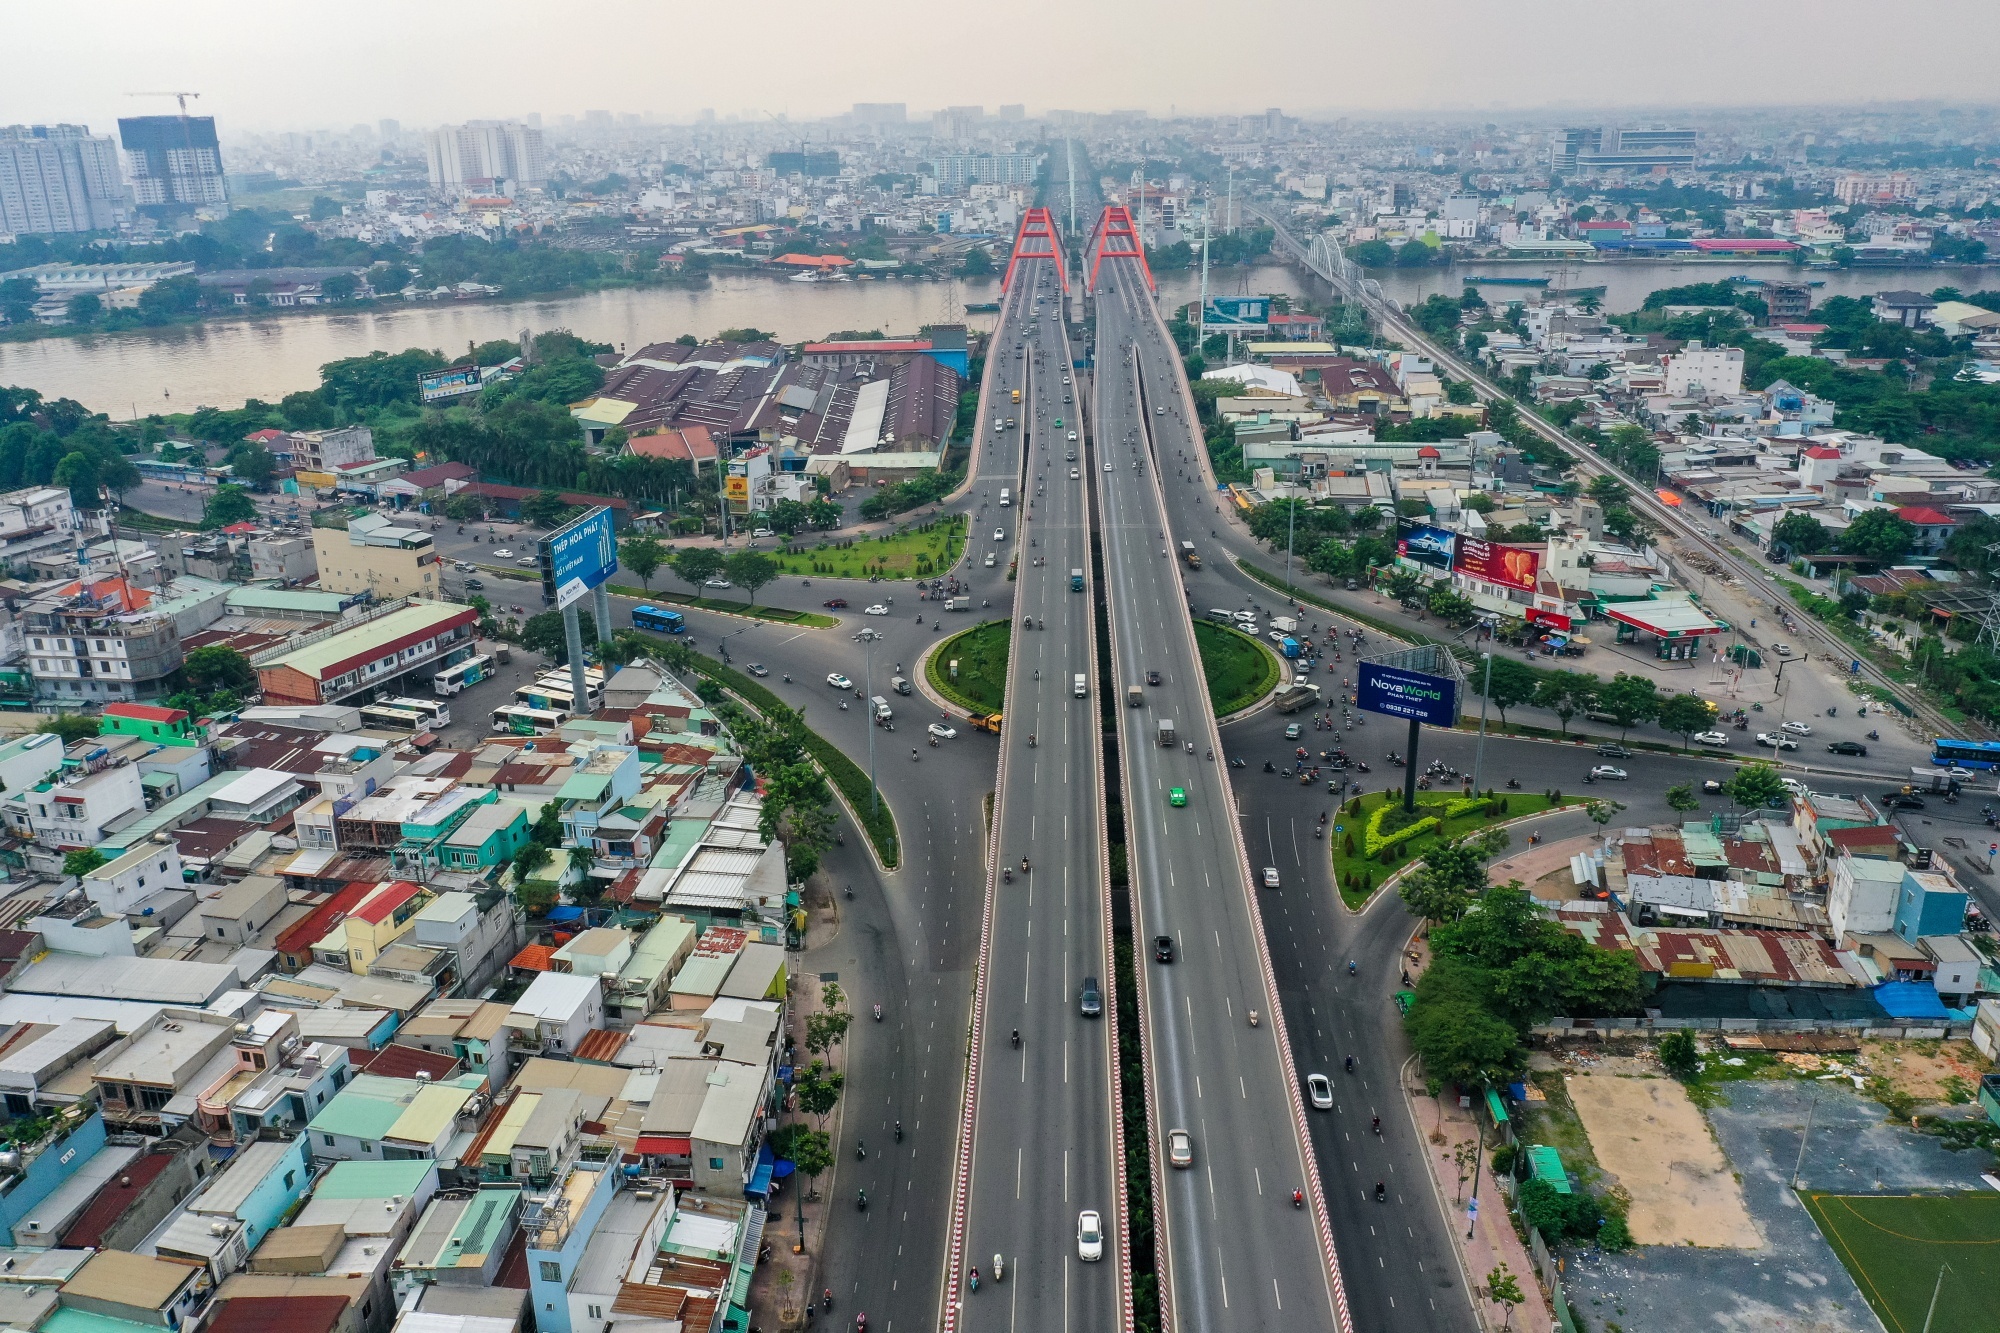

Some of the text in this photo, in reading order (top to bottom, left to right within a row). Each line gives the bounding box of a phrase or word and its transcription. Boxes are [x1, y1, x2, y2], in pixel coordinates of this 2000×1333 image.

[554, 521, 598, 555] THÉP HÒA PHÁT
[556, 566, 562, 577] SỐ
[565, 560, 574, 571] VIỆT
[574, 555, 584, 566] NAM
[1371, 678, 1440, 700] NovaWorld
